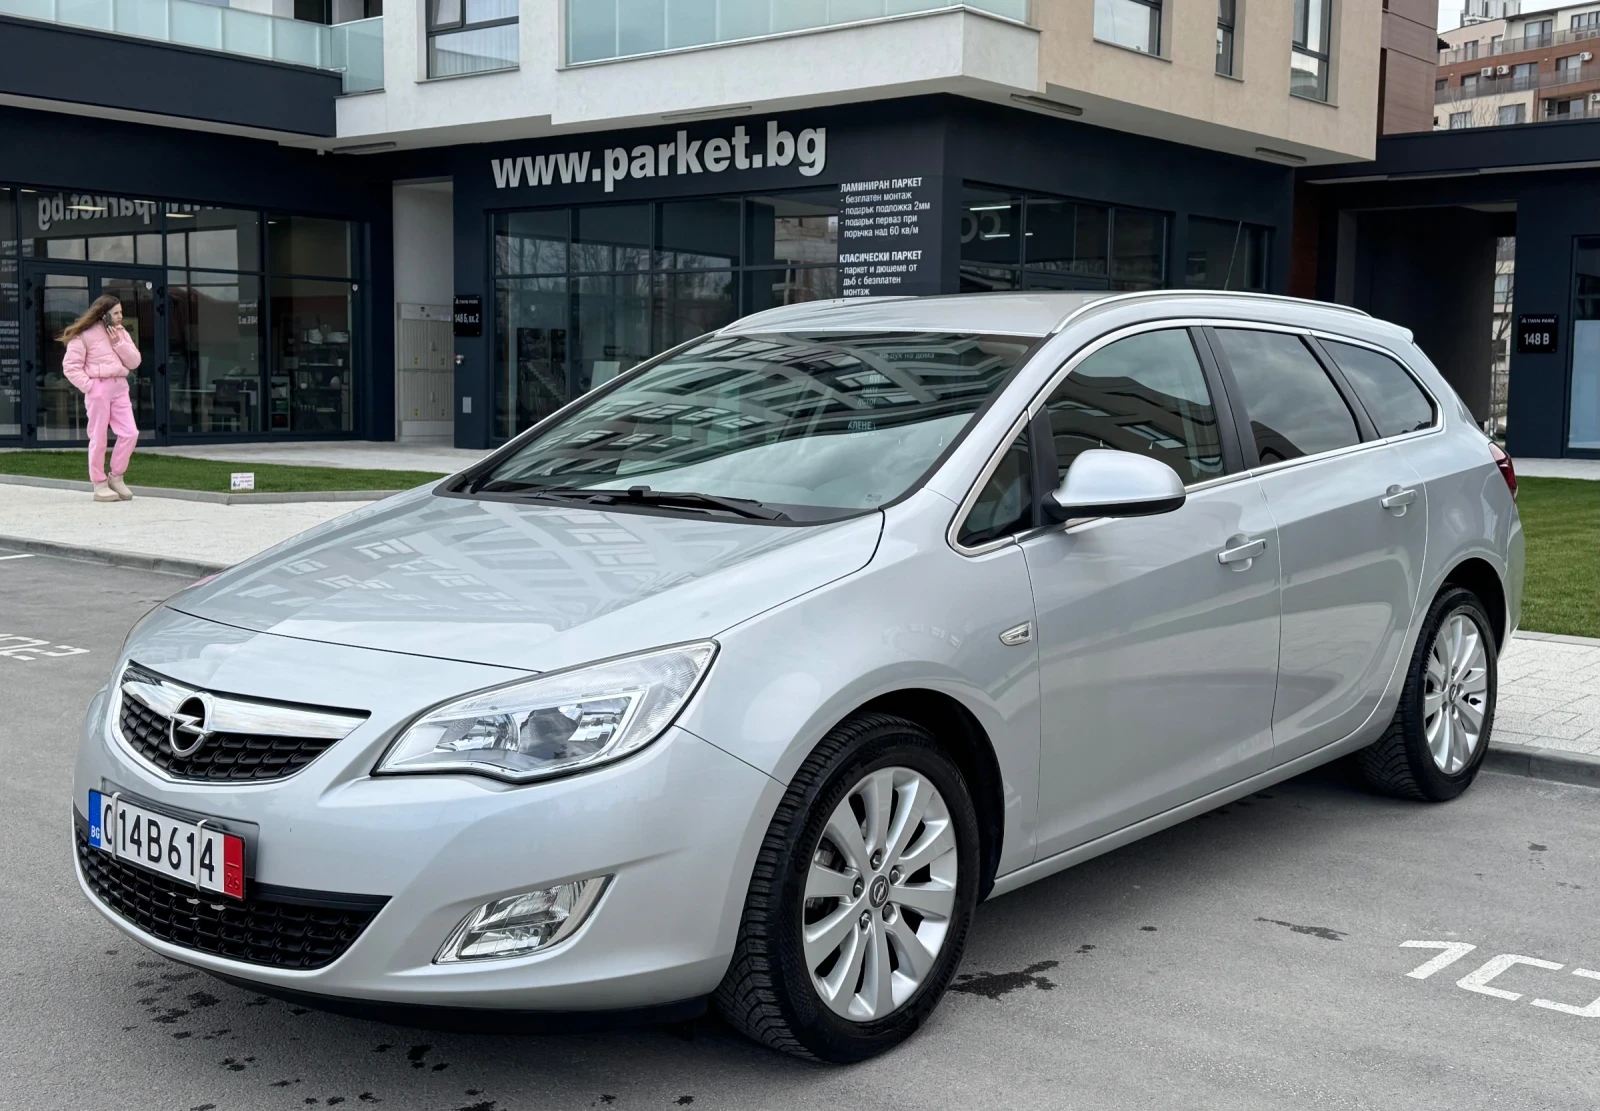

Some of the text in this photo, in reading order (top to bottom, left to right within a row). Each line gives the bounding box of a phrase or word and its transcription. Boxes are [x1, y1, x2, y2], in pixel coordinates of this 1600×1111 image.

[491, 120, 827, 193] www.parket.bg
[840, 177, 923, 193] ЛАМИНИРАН ПАРКЕТ
[883, 191, 913, 201] монтаж
[875, 203, 912, 213] подложка
[913, 201, 931, 210] 2мм
[875, 216, 902, 226] перваз
[903, 215, 918, 224] при
[874, 227, 888, 236] над
[889, 226, 900, 235] 60
[901, 225, 919, 236] кв/м
[839, 250, 923, 263] КЛАСИЧЕСКИ ПАРКЕТ
[844, 265, 868, 276] паркет
[875, 264, 907, 274] дюшеме
[908, 264, 918, 272] от
[863, 276, 902, 285] безплатен
[843, 288, 870, 296] монтаж
[1524, 332, 1541, 345] 148
[91, 825, 101, 840] BG
[226, 872, 240, 890] 26
